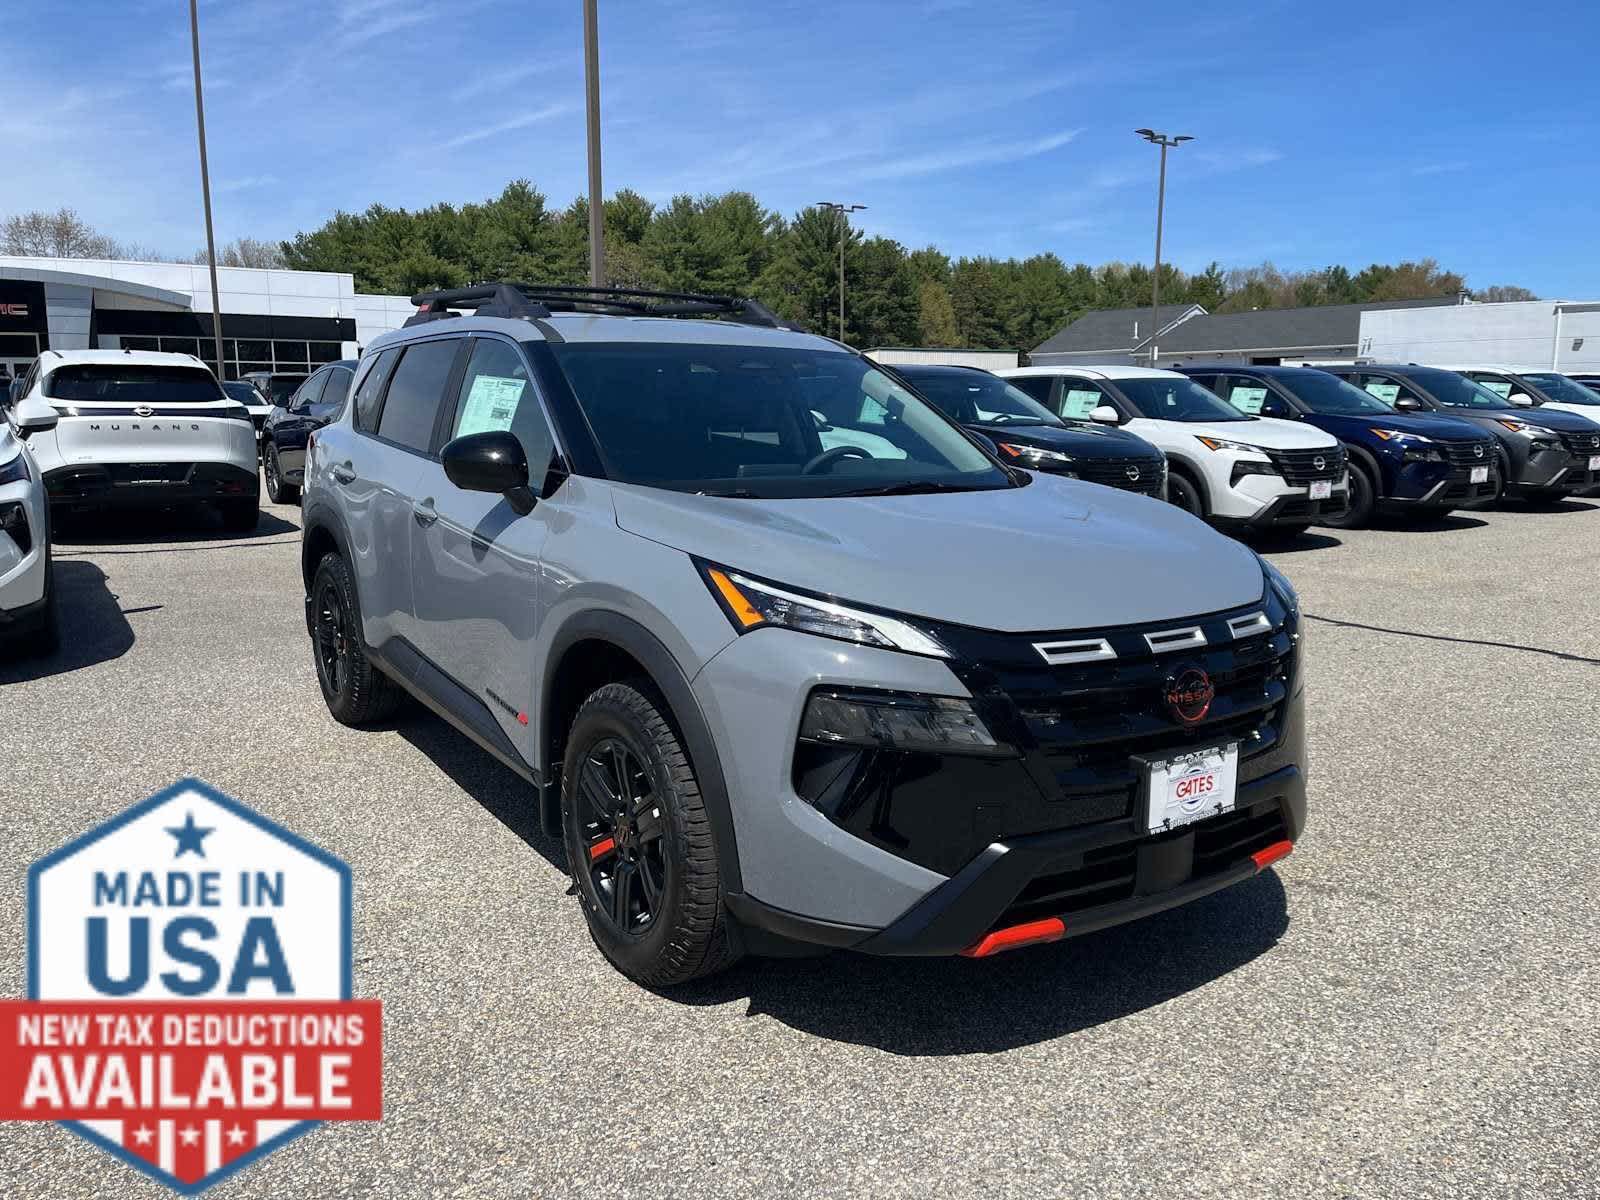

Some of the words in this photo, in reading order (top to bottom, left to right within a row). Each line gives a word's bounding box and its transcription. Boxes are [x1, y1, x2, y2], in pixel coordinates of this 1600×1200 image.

[0, 303, 28, 315] C
[90, 424, 200, 432] MURANO
[1176, 775, 1214, 798] GATES
